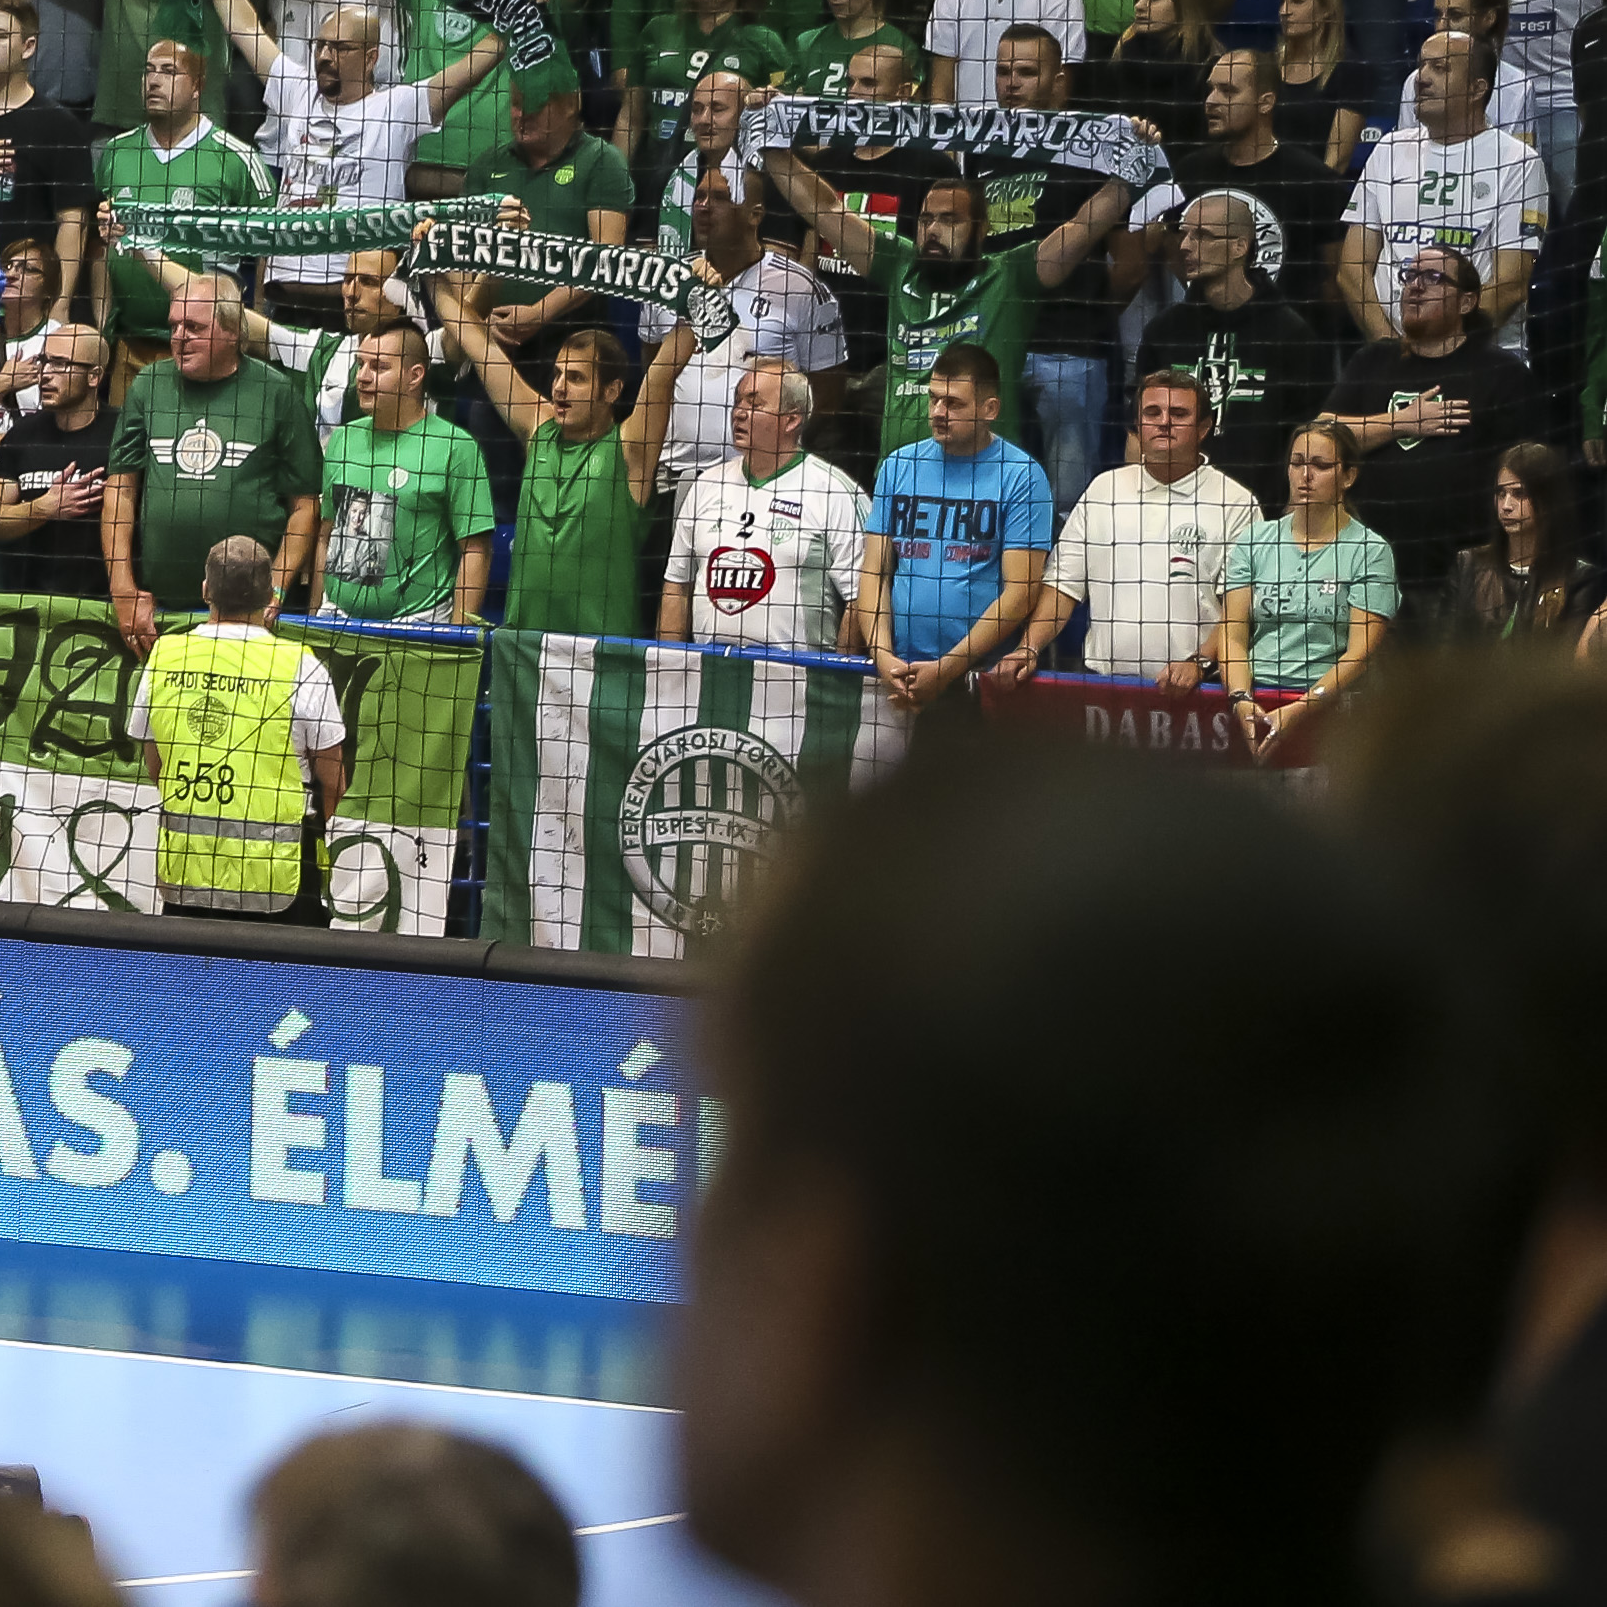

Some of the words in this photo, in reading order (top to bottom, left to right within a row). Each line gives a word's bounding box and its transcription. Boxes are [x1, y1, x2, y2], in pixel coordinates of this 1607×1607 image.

[687, 48, 707, 81] 9
[775, 101, 1107, 162] FERENCVAROS
[1418, 170, 1458, 206] 22
[427, 220, 693, 302] FERENCVÁROS
[736, 511, 756, 538] 2
[891, 496, 995, 540] RETRO
[710, 567, 764, 590] HERZ
[163, 670, 198, 690] FRADI
[201, 673, 270, 696] SECURITY
[1084, 705, 1230, 751] DABAS
[174, 760, 236, 805] 558
